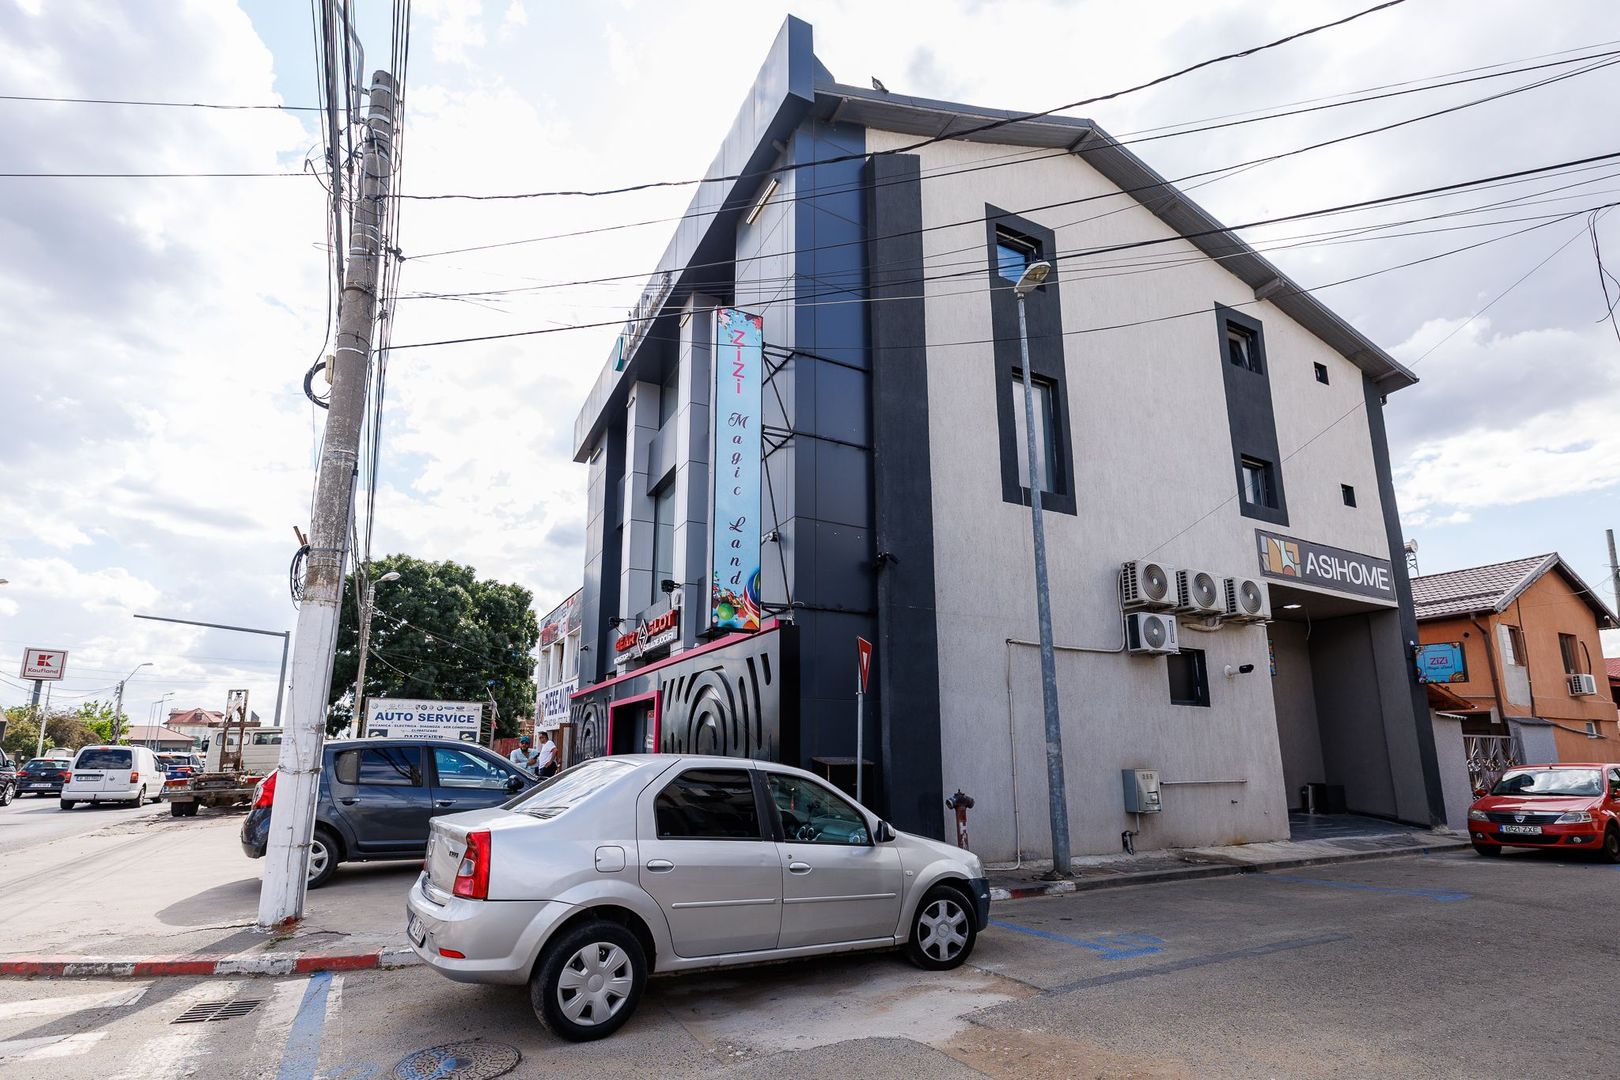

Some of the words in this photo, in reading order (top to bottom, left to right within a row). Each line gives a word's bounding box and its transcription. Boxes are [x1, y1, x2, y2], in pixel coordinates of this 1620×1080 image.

[727, 412, 750, 496] Magic
[728, 516, 747, 585] Land
[1306, 551, 1390, 591] ASIHOME
[375, 712, 414, 721] AUTO
[418, 714, 475, 723] SERVICE
